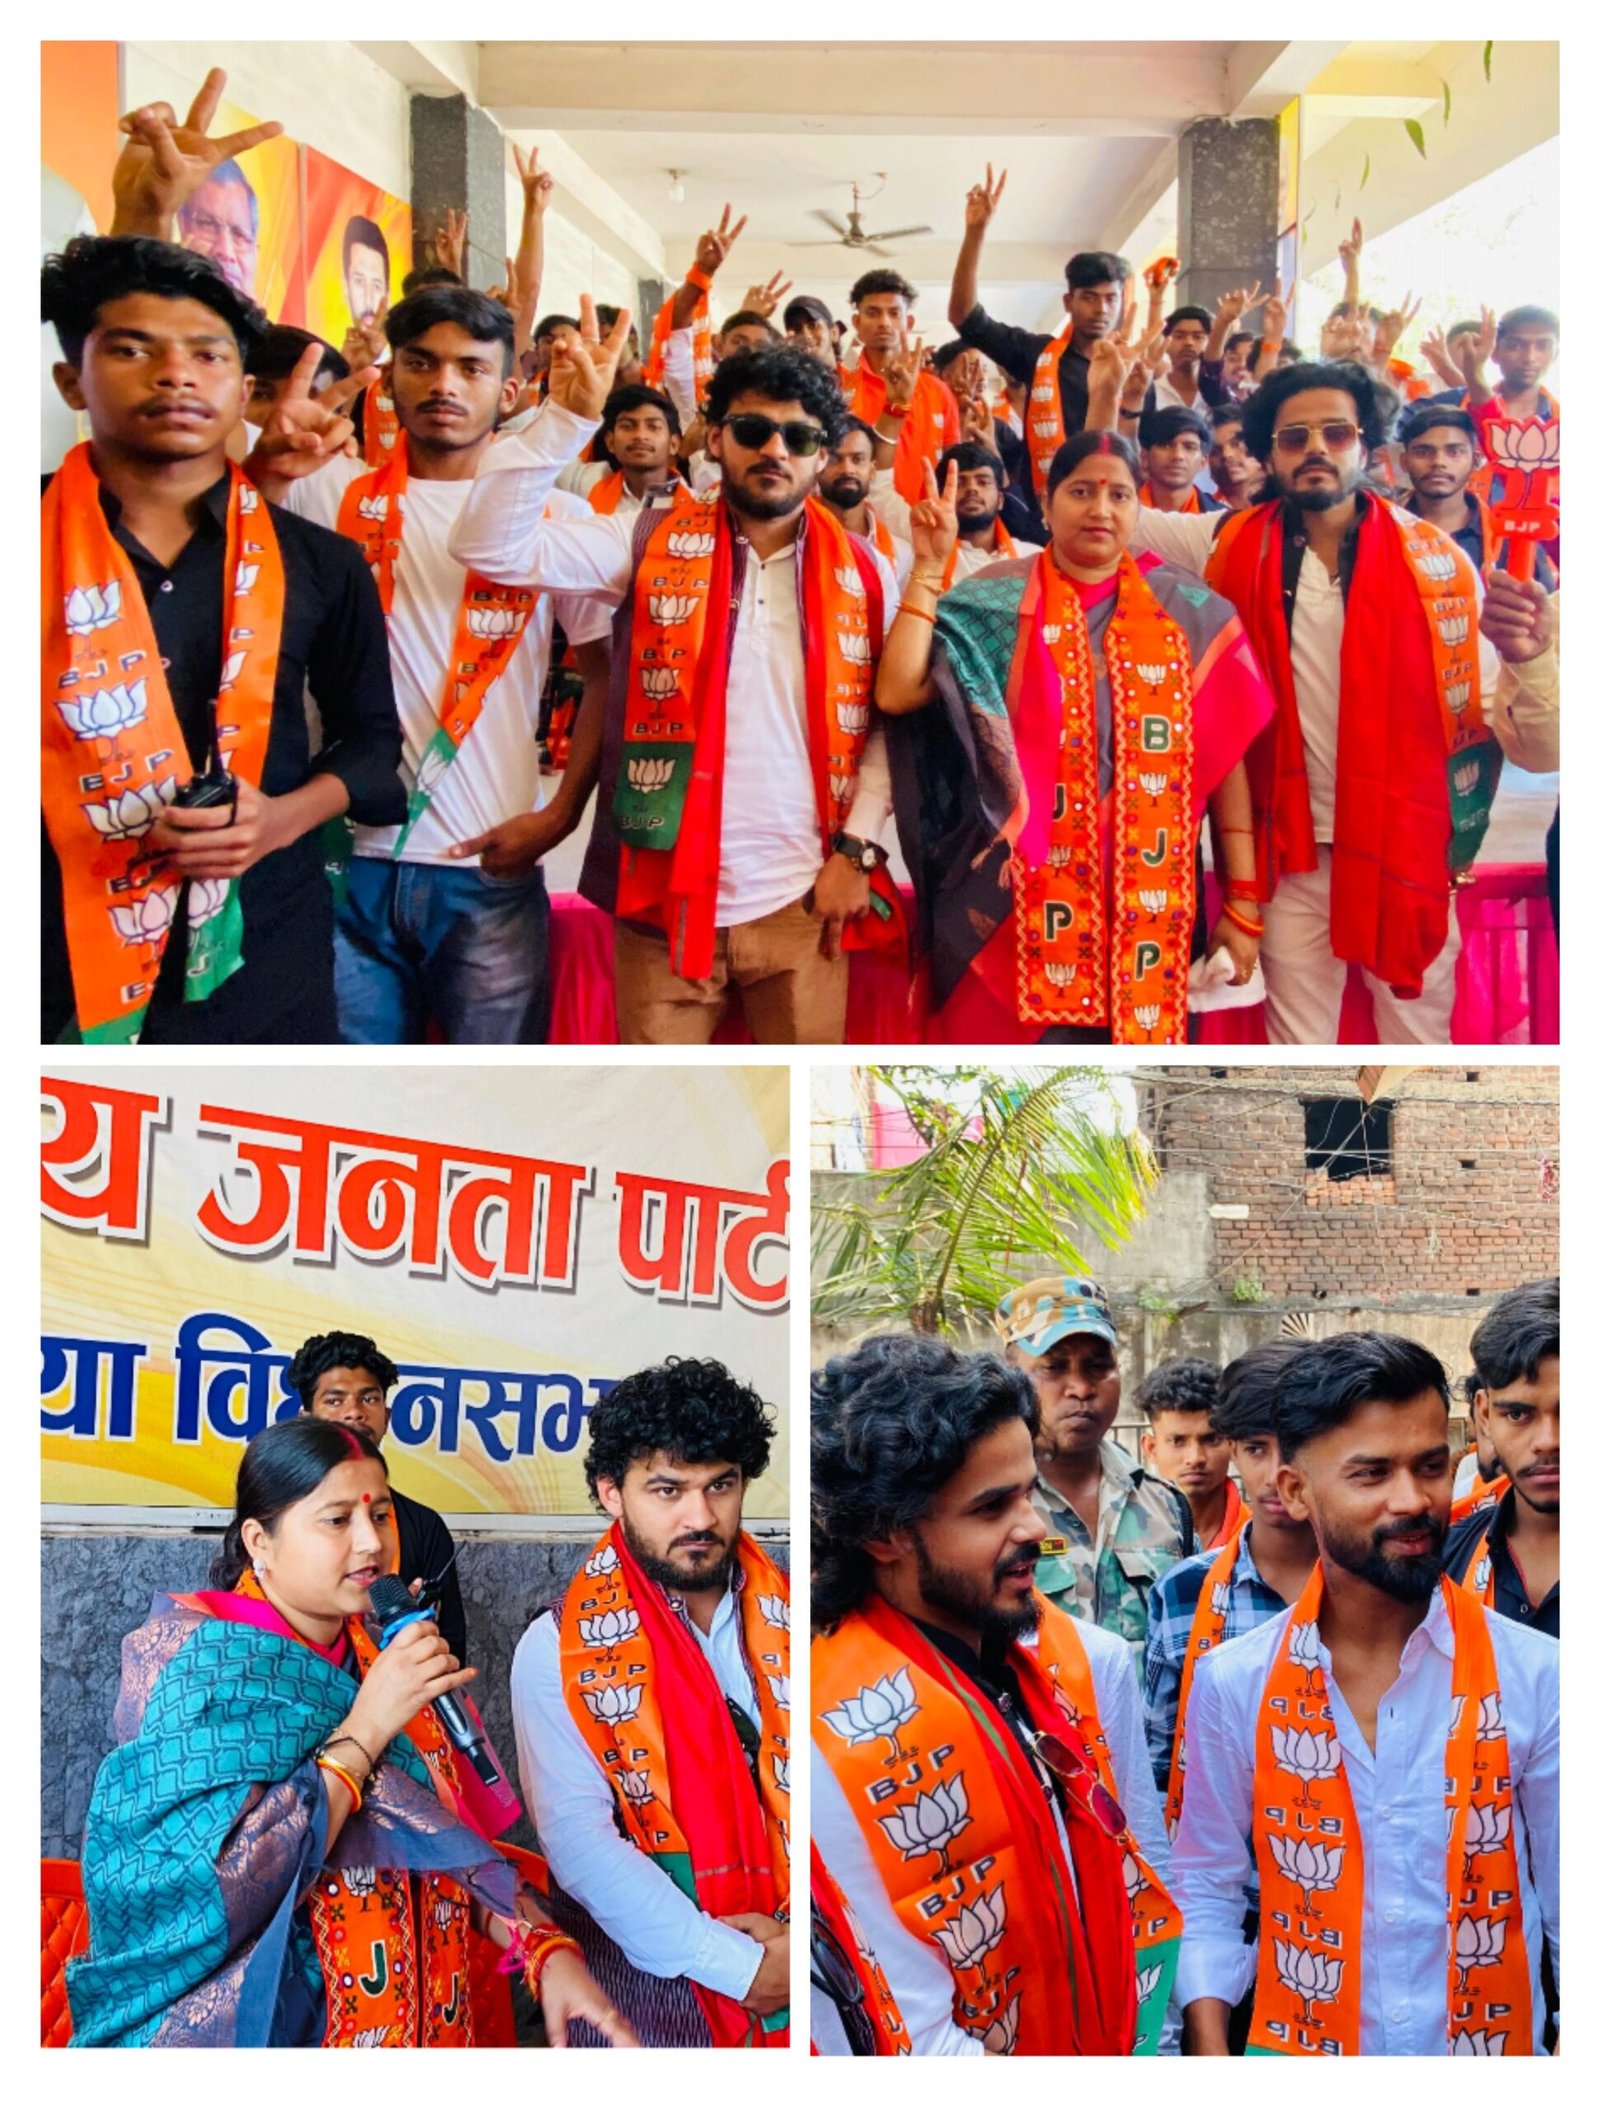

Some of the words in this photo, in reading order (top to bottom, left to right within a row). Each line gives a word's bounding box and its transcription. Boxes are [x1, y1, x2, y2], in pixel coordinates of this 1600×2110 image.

[1504, 520, 1541, 532] BJP
[652, 576, 709, 588] BJP
[473, 591, 532, 604] BJP
[1433, 597, 1468, 613] BJP
[641, 648, 687, 661] BP
[59, 650, 147, 689] BJP
[1443, 661, 1473, 681] BJP
[632, 722, 684, 736] BJP
[620, 815, 665, 830] BJP
[198, 1104, 586, 1280] जनता
[579, 1590, 634, 1612] BJ
[579, 1663, 647, 1684] BJP
[602, 1748, 649, 1766] BP
[864, 1743, 955, 1806] BJP
[1471, 1776, 1512, 1796] JP
[915, 1855, 997, 1921] BJP
[1459, 1889, 1513, 1910] JP
[1453, 2001, 1513, 2022] JP
